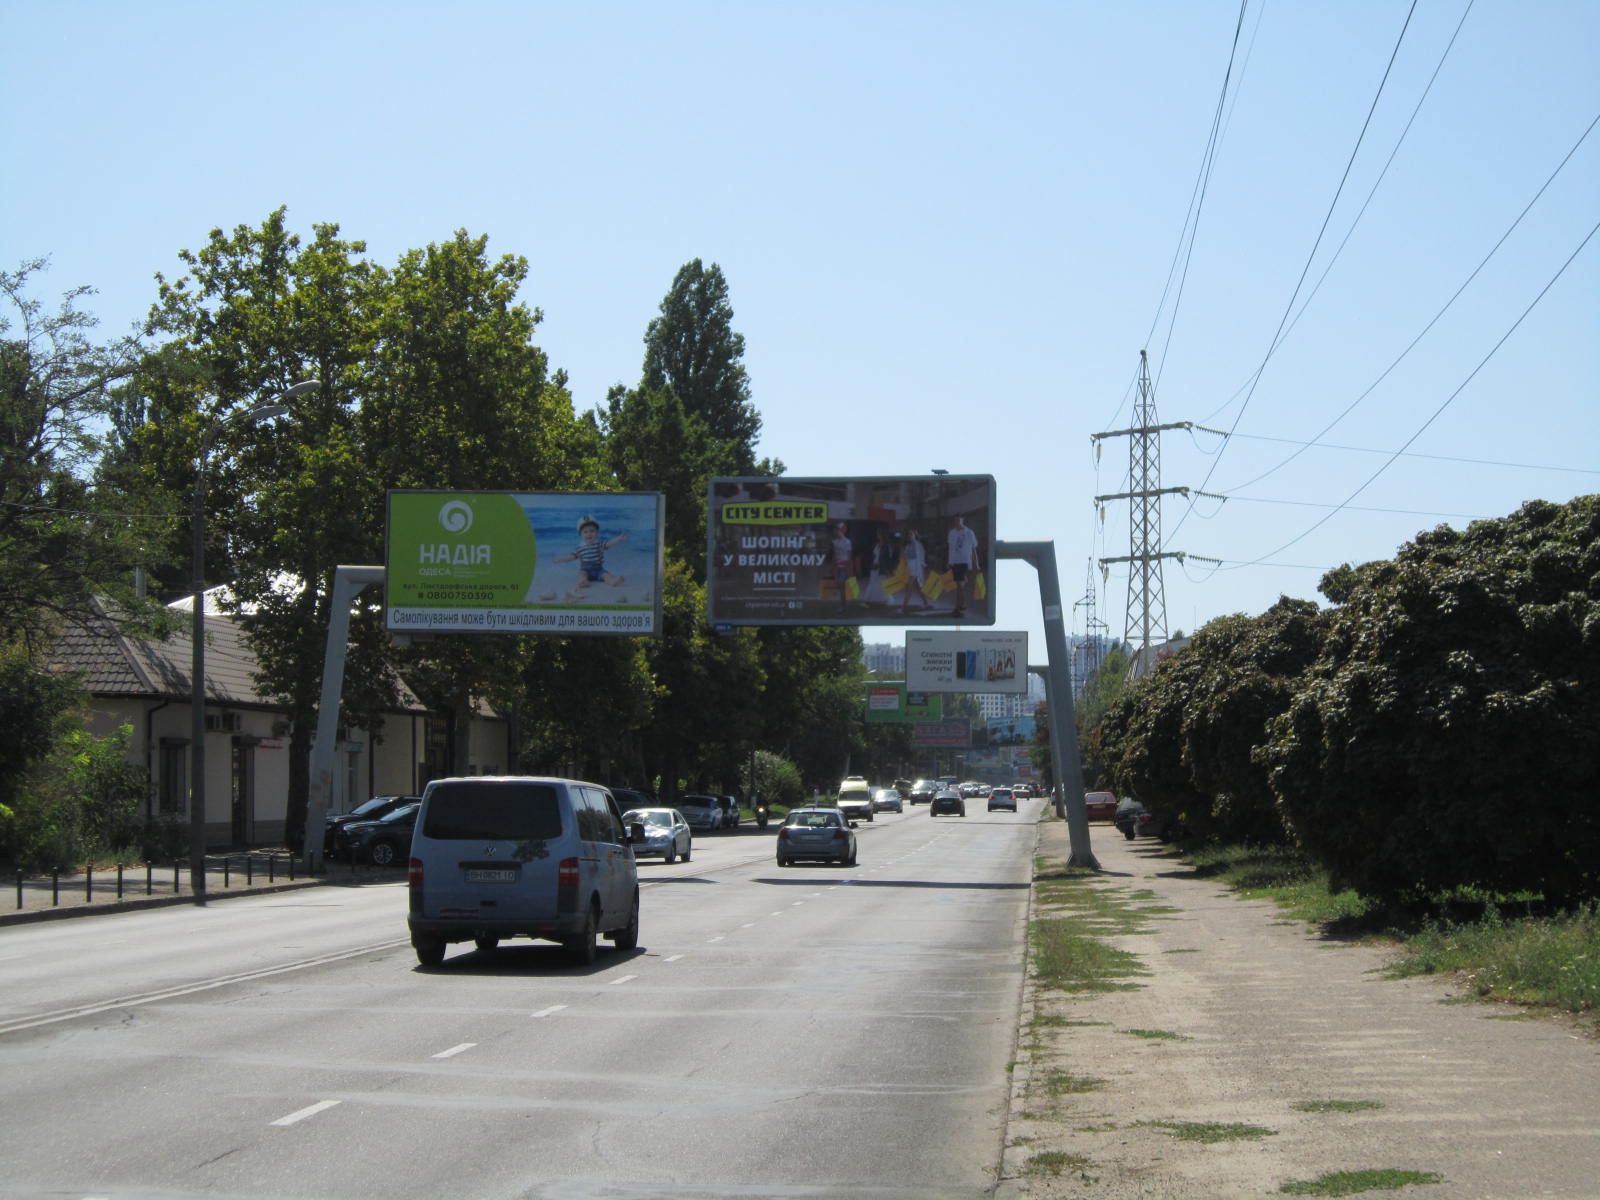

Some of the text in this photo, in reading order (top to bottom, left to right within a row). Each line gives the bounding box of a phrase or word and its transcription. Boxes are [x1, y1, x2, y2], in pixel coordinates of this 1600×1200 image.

[726, 507, 824, 519] CITY CENTER
[741, 536, 806, 549] ШОПІНГ
[419, 543, 491, 565] НАДІЯ
[723, 553, 826, 567] У ВЕЛИКОМУ
[753, 572, 796, 584] МІСТІ
[393, 609, 651, 629] Самолікування може бути шкідливим для вашого здоров'я
